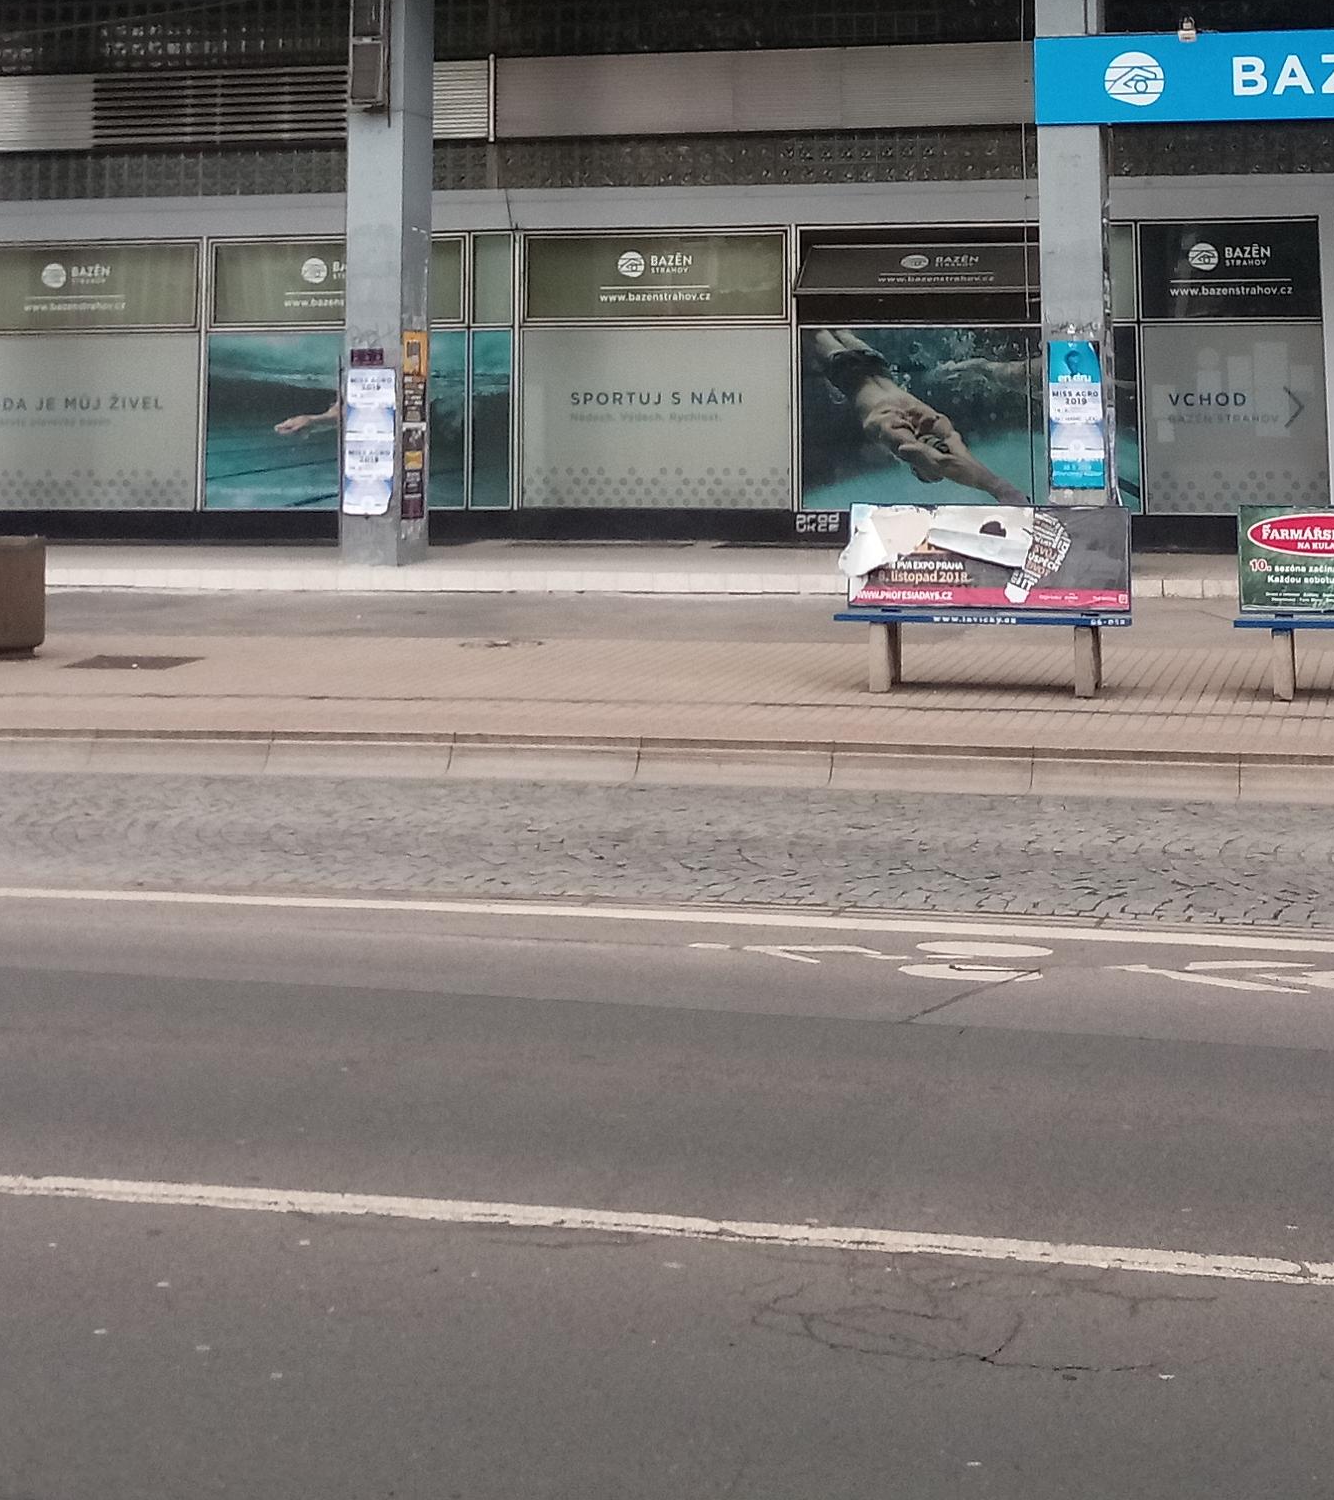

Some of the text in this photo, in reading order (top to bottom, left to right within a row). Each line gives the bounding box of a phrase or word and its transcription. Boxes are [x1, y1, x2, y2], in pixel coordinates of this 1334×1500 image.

[1224, 243, 1271, 258] BAZÉN
[650, 252, 692, 266] BAZÉN
[1225, 259, 1267, 267] STRAHOV
[71, 264, 110, 278] BAZÉN
[599, 291, 711, 302] www.bazenstrahov.cz
[1170, 285, 1293, 296] www.bazenstrahov.cz
[35, 397, 56, 412] JE
[64, 393, 101, 411] MŮJ
[109, 391, 164, 411] ŽIVEL
[570, 388, 743, 405] SPORTUJ S NÁMI
[1169, 393, 1247, 407] VCHOD
[1217, 413, 1279, 423] STRAHOV
[896, 561, 913, 570] PVA
[913, 561, 935, 570] EXPO
[936, 561, 964, 571] PRAHA
[891, 569, 938, 586] listopad
[939, 571, 969, 583] 2018
[1267, 574, 1301, 584] Každou
